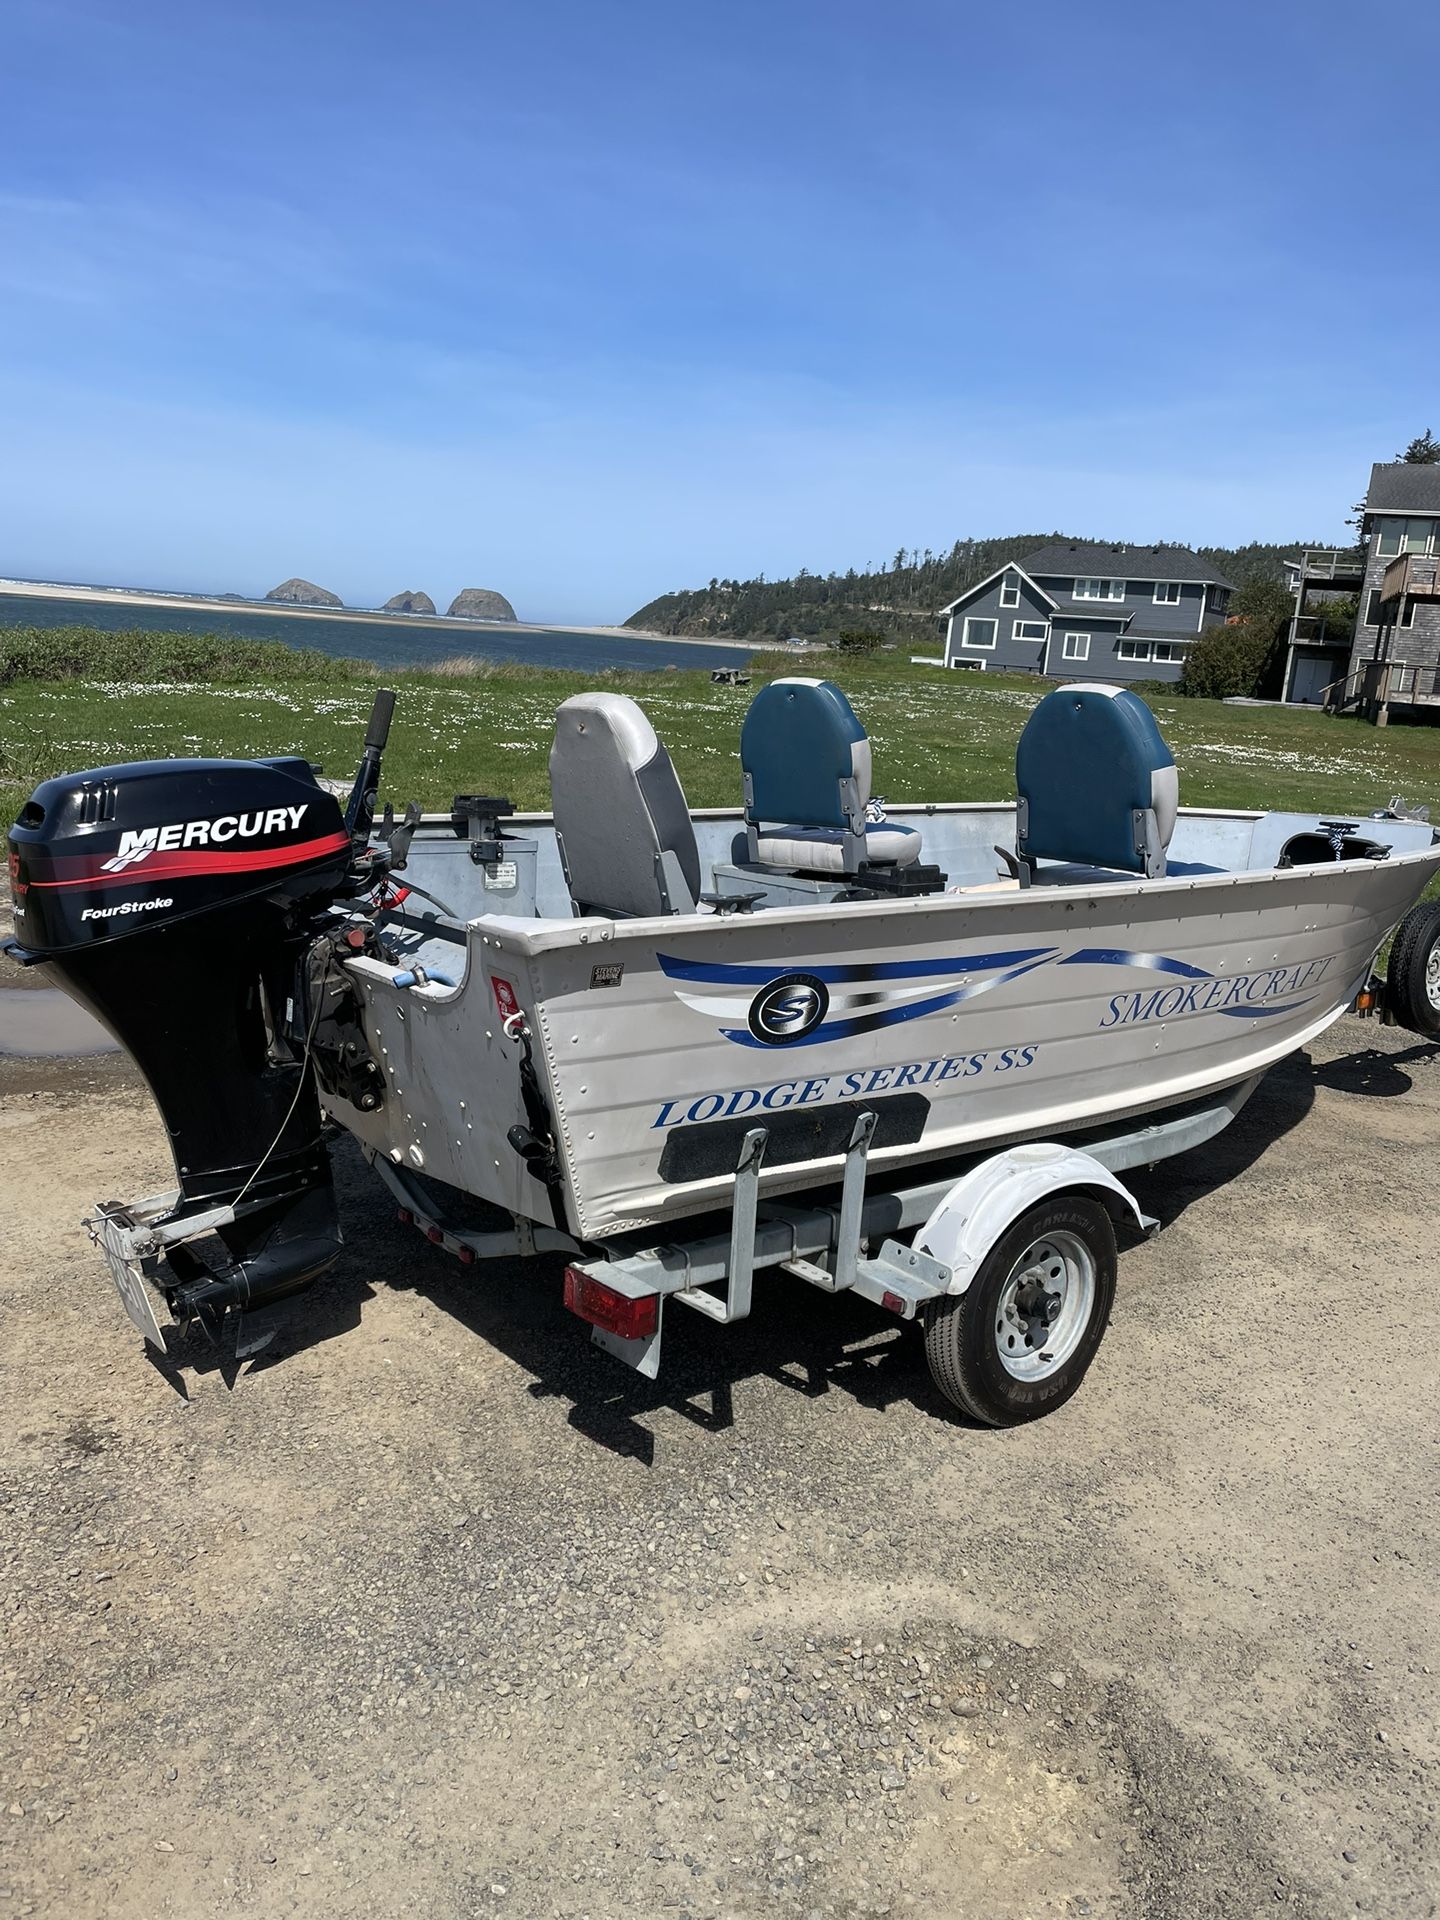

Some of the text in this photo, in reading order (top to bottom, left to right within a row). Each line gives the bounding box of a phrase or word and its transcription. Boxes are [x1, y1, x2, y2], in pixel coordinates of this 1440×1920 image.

[101, 804, 308, 872] MERCURY
[81, 897, 173, 921] FourStroke
[1099, 956, 1336, 1027] SMOKERCRAFT
[650, 1045, 1040, 1129] LODGE SERIES SS
